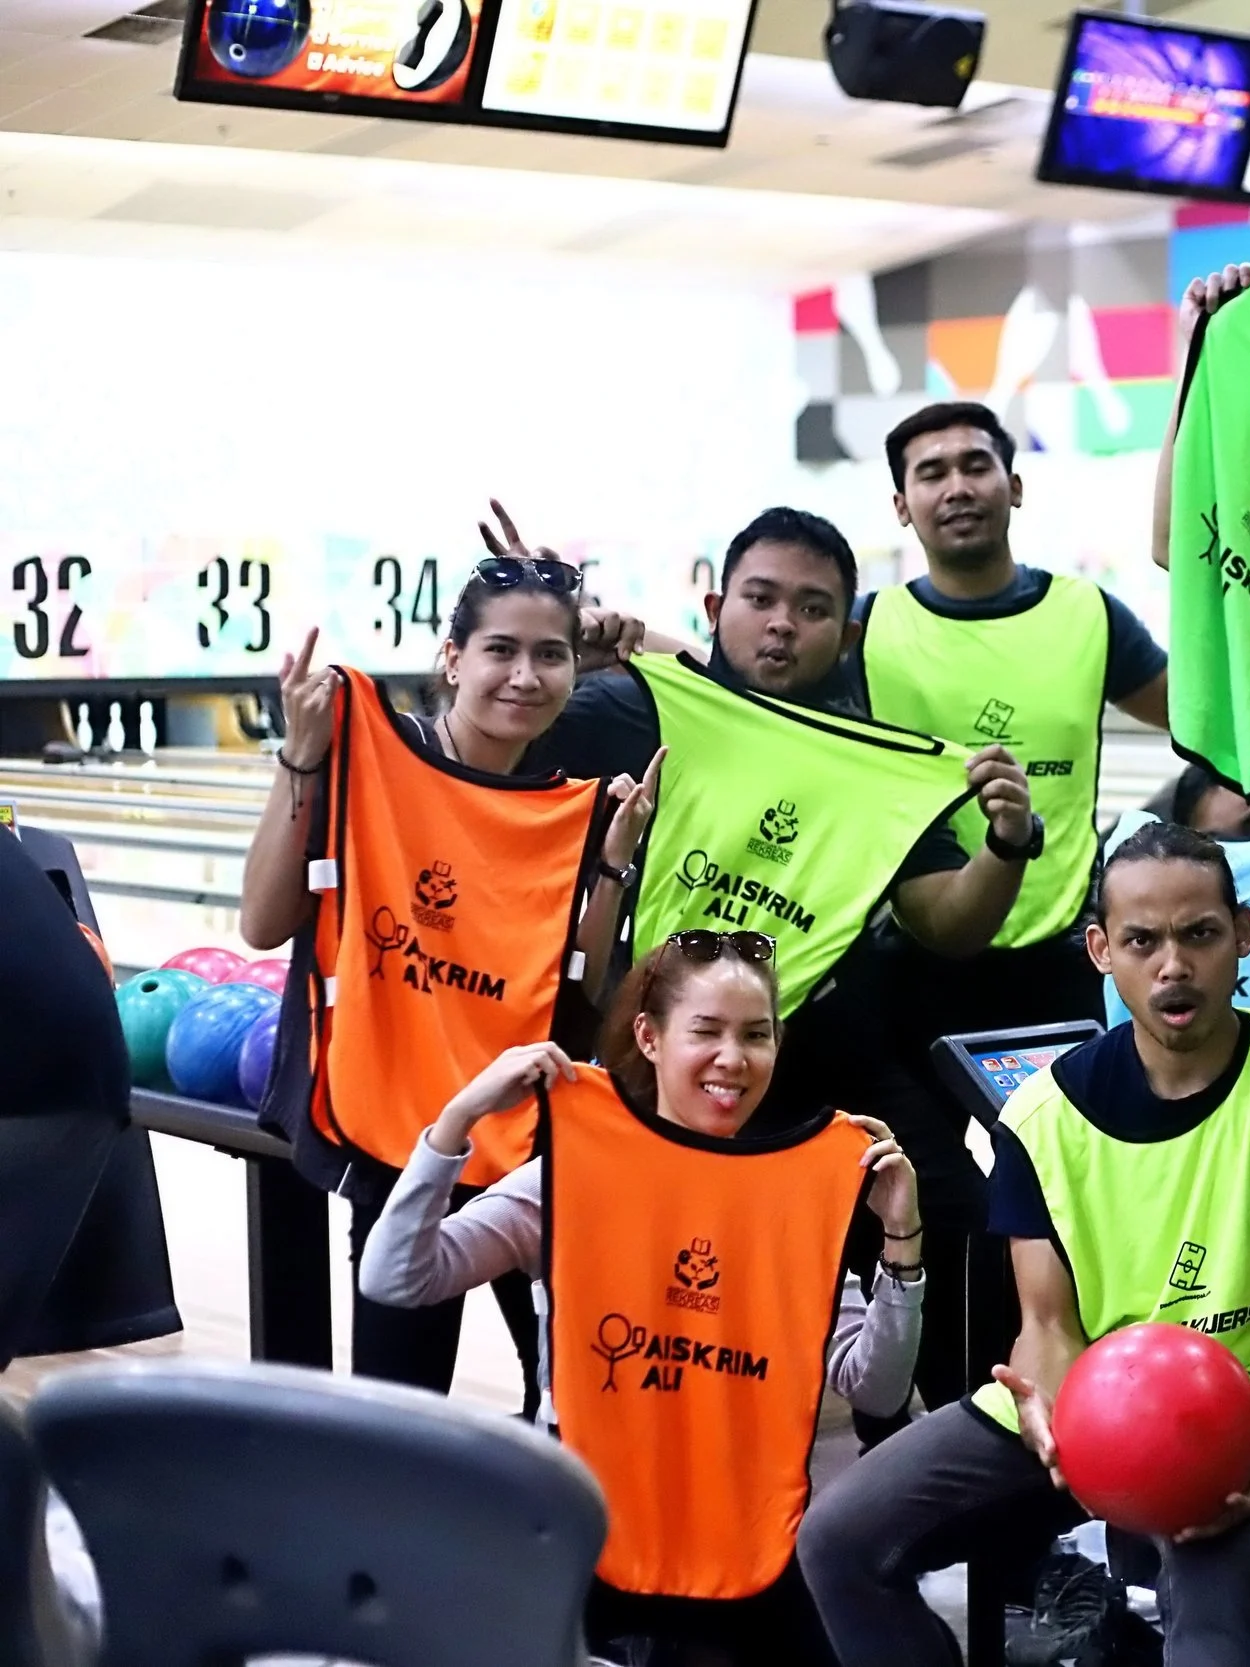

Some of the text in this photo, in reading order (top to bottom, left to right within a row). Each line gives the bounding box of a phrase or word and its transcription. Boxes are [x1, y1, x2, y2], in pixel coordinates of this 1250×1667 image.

[322, 53, 385, 77] Advice
[12, 556, 92, 658] 32
[198, 556, 271, 652] 33
[373, 557, 442, 647] 34
[703, 897, 749, 926] ALI
[711, 873, 816, 933] AISKRIM
[640, 1365, 684, 1392] ALI
[644, 1335, 769, 1381] AISKRIM
